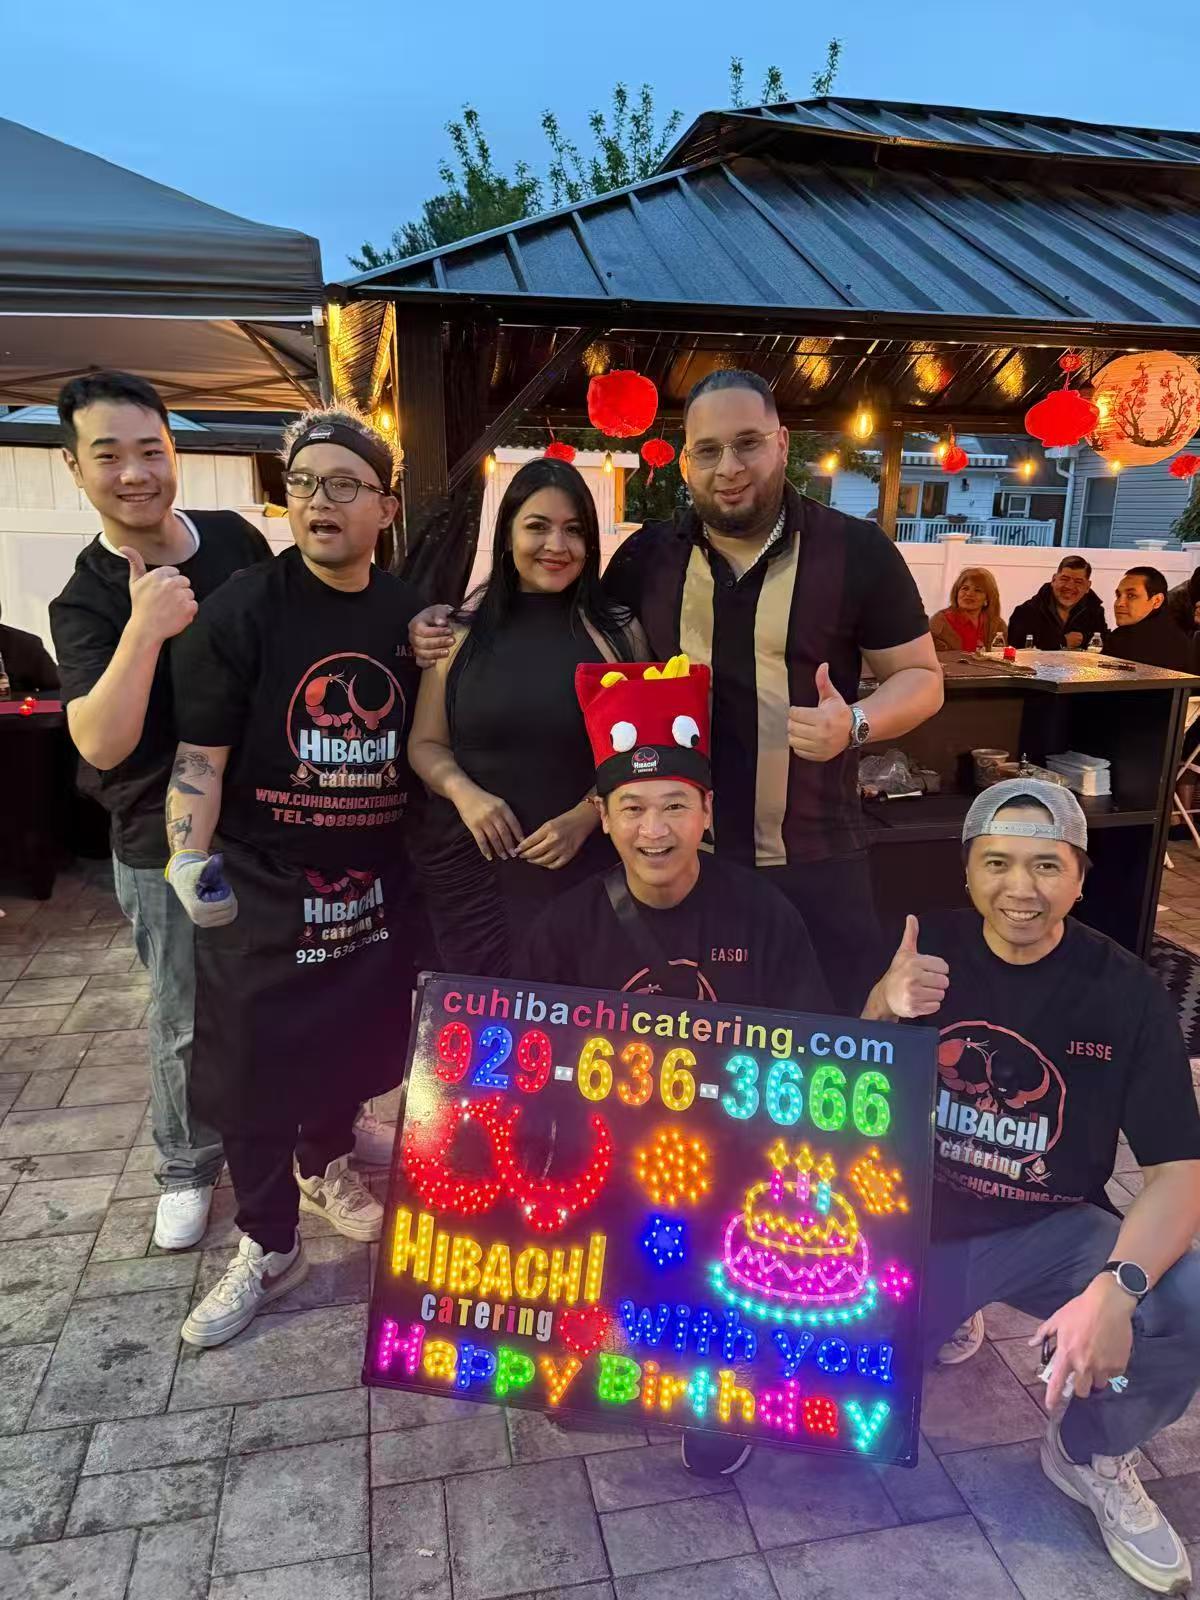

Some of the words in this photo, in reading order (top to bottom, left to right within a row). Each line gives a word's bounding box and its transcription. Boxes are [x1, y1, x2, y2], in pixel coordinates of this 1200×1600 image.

[300, 729, 395, 763] HIBACHI
[303, 877, 384, 924] HIBACHI
[443, 988, 895, 1064] cuhibachicatering.com
[1066, 1040, 1113, 1061] JESSE
[435, 1021, 892, 1138] 929-636-3666
[391, 1208, 607, 1303] HIBACHI
[378, 1318, 583, 1405] Happy
[598, 1352, 891, 1450] Birthday
